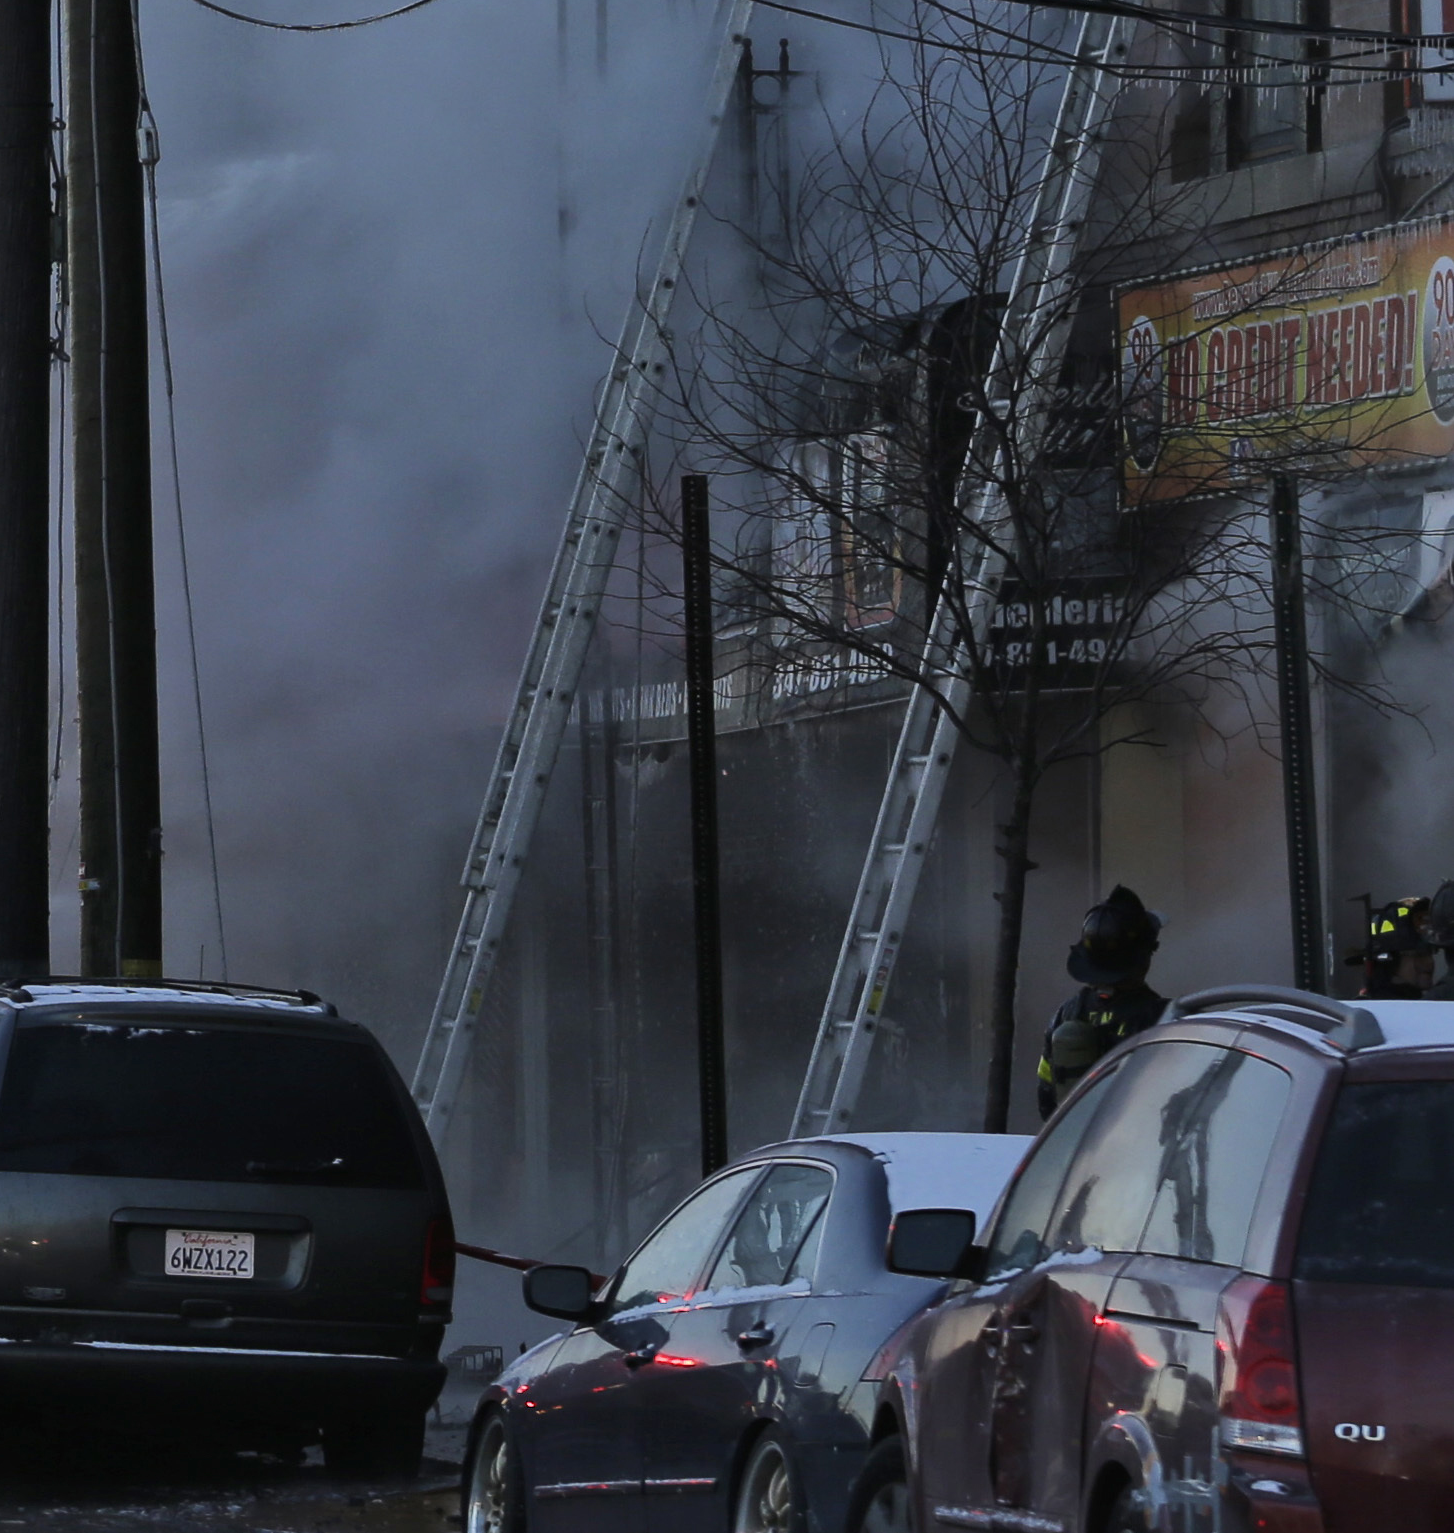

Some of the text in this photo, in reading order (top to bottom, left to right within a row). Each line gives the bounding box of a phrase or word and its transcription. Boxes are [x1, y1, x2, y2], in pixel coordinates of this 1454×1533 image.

[1165, 330, 1201, 425] NO
[1205, 316, 1302, 427] CREDIT
[1303, 289, 1419, 413] NEEDED!
[171, 1247, 249, 1272] 6WZX122
